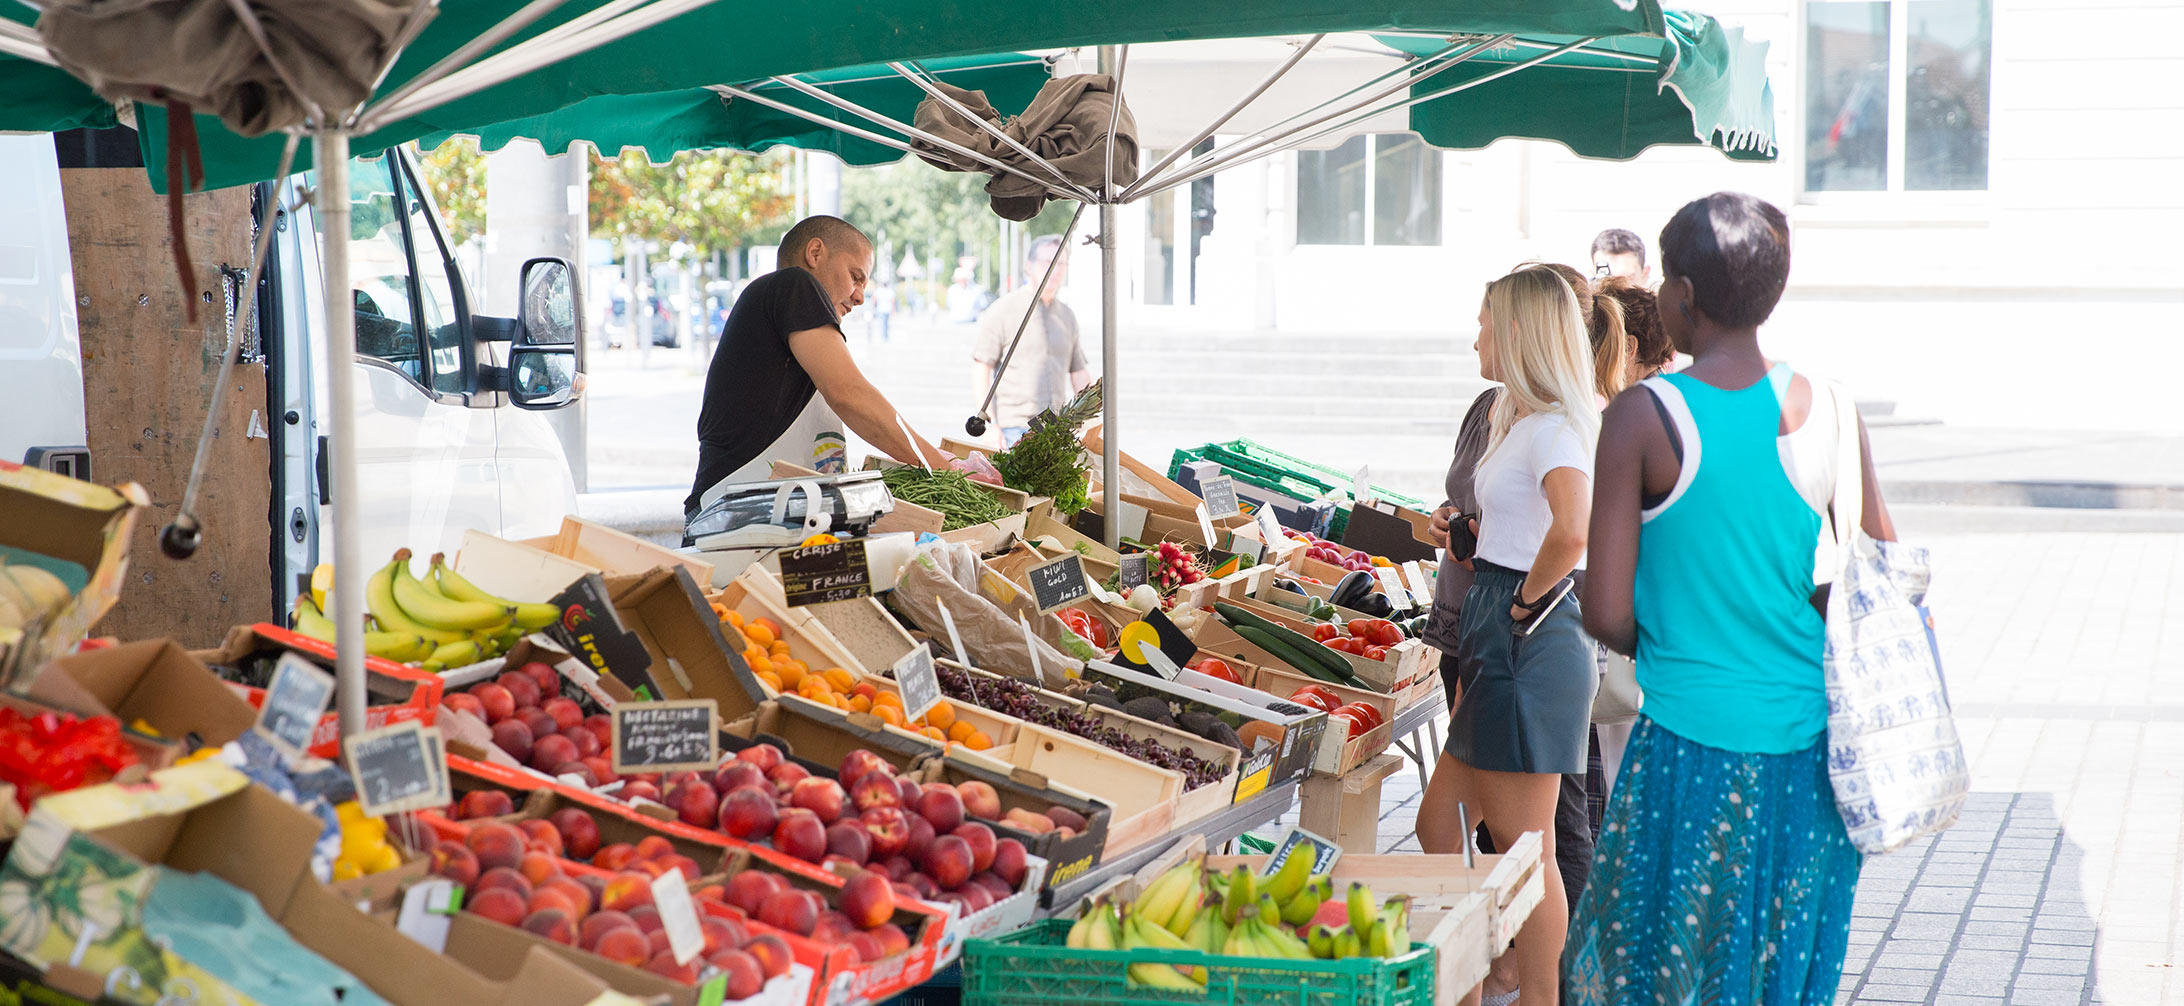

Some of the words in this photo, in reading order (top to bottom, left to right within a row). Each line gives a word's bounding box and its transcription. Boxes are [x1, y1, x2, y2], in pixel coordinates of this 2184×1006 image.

[792, 543, 841, 560] CERISE
[812, 572, 864, 591] FRANCE
[1047, 572, 1068, 586] GOLD
[1049, 853, 1094, 887] irene
